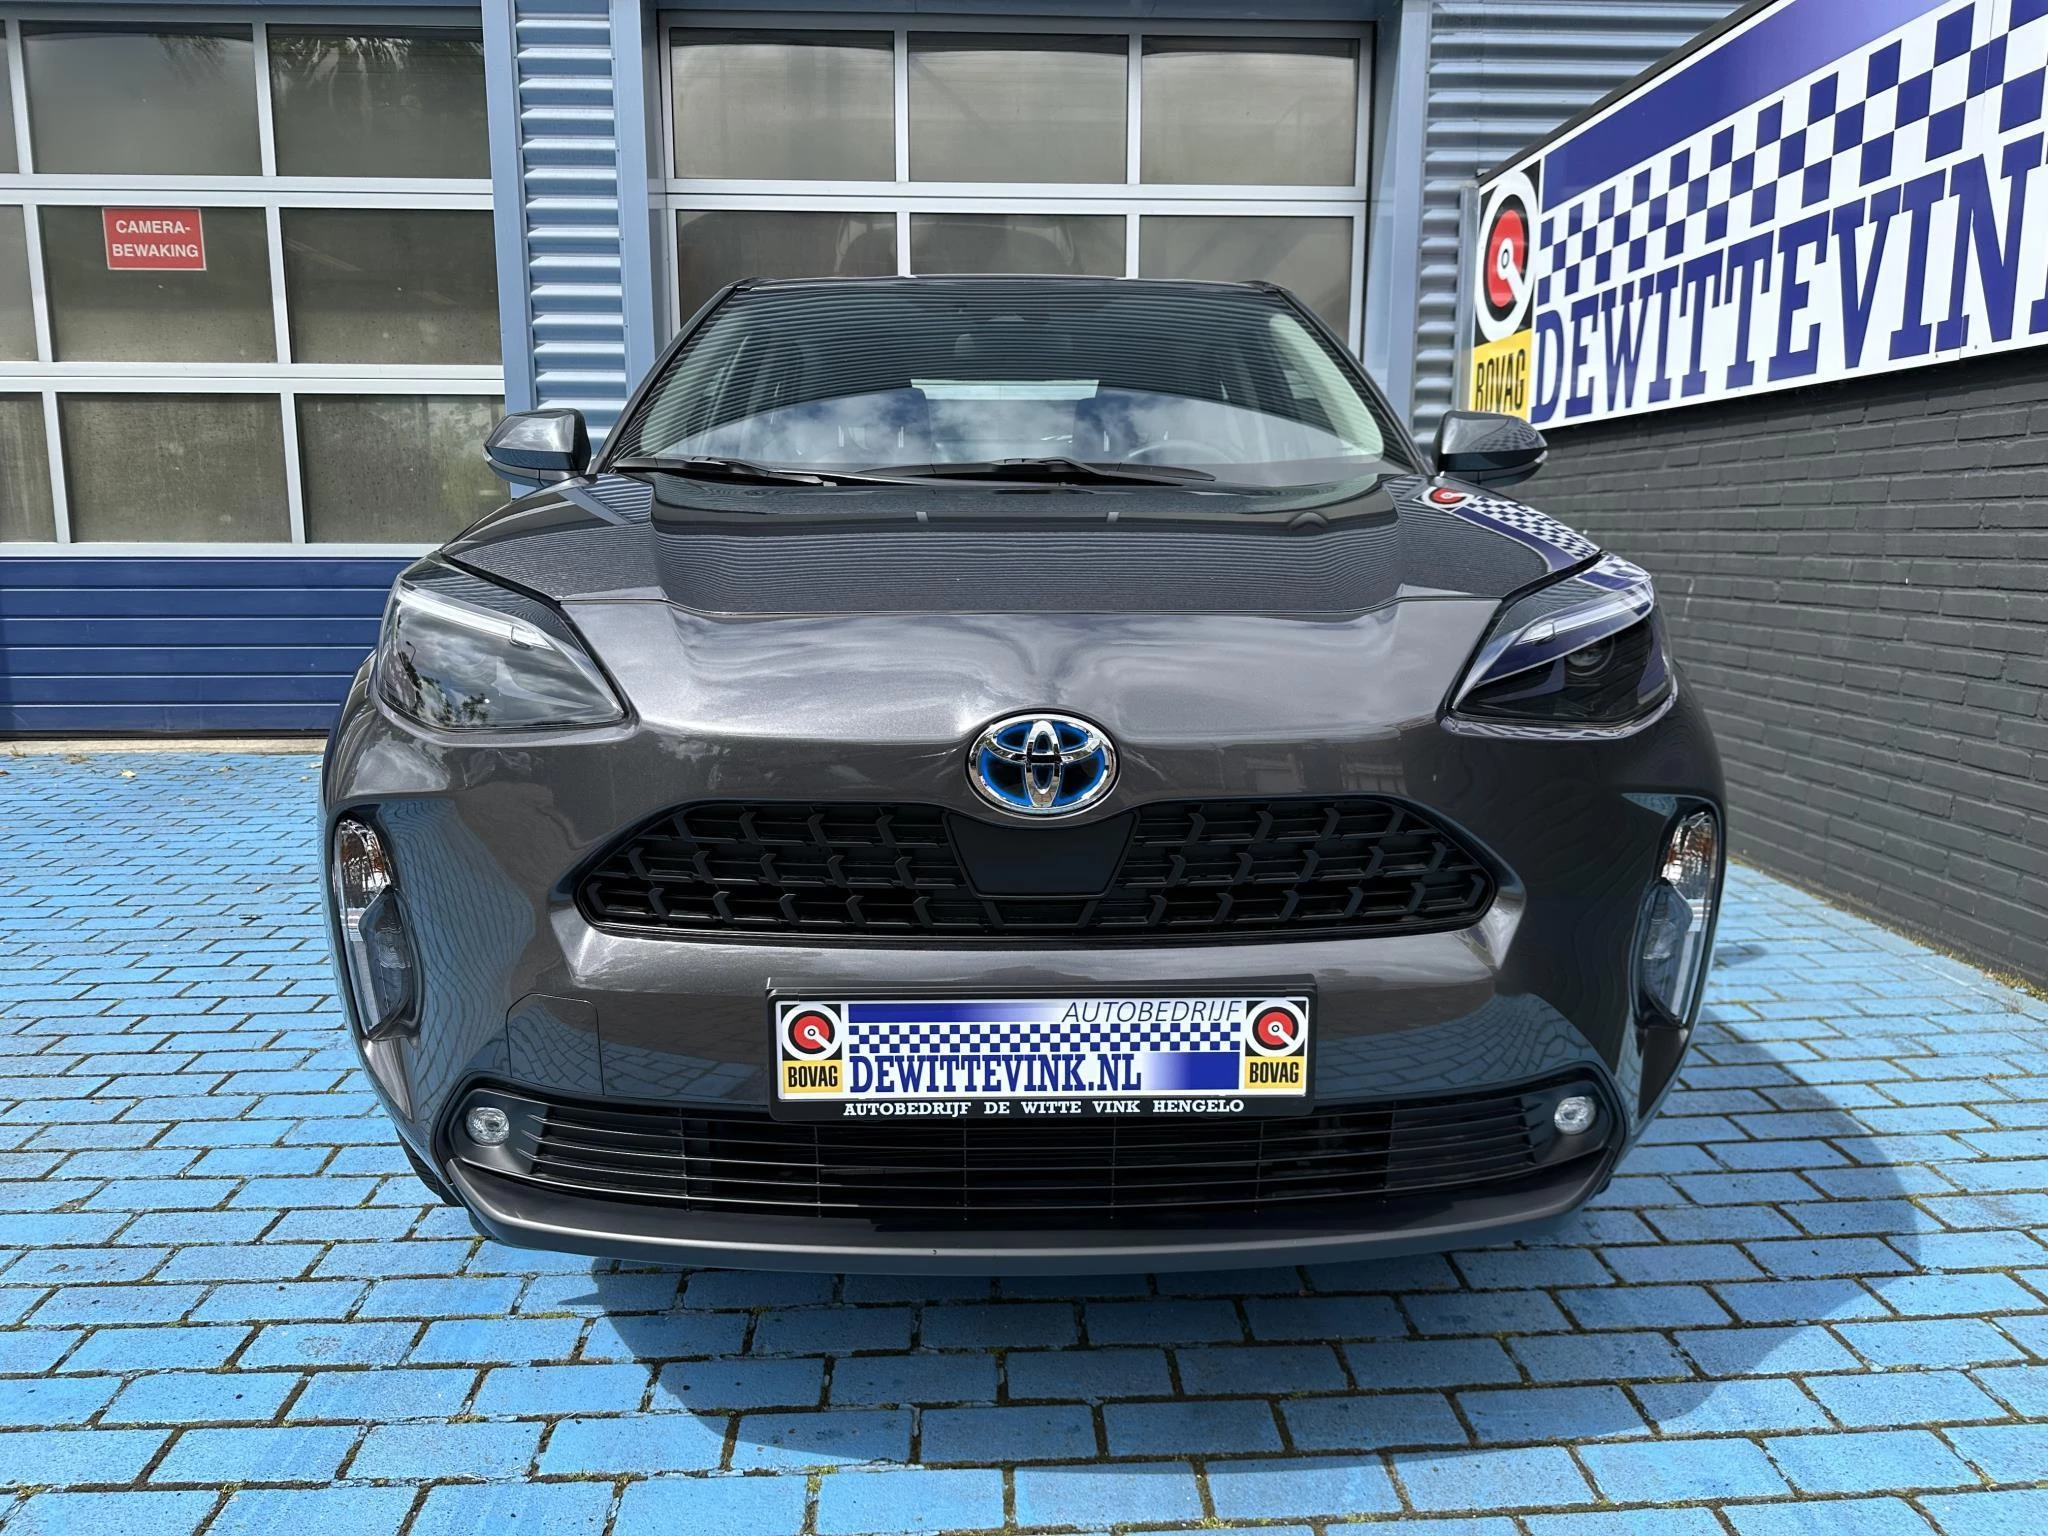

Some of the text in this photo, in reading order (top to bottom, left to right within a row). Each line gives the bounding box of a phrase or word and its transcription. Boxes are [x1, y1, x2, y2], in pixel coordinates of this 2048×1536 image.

[115, 219, 191, 234] CAMERA-
[112, 243, 199, 258] BEWAKING
[1531, 132, 2048, 425] DEWITTEVIN
[1475, 348, 1525, 412] BOVAG
[1061, 1000, 1242, 1023] AUTOBEDRIJF
[788, 1065, 838, 1088] BOVAG
[849, 1053, 1142, 1093] DEWITTEVINK.NL
[1249, 1061, 1299, 1084] BOVAG
[843, 1099, 1245, 1118] AUTOBEDRIJF DE WITTE VINK HENGELO
